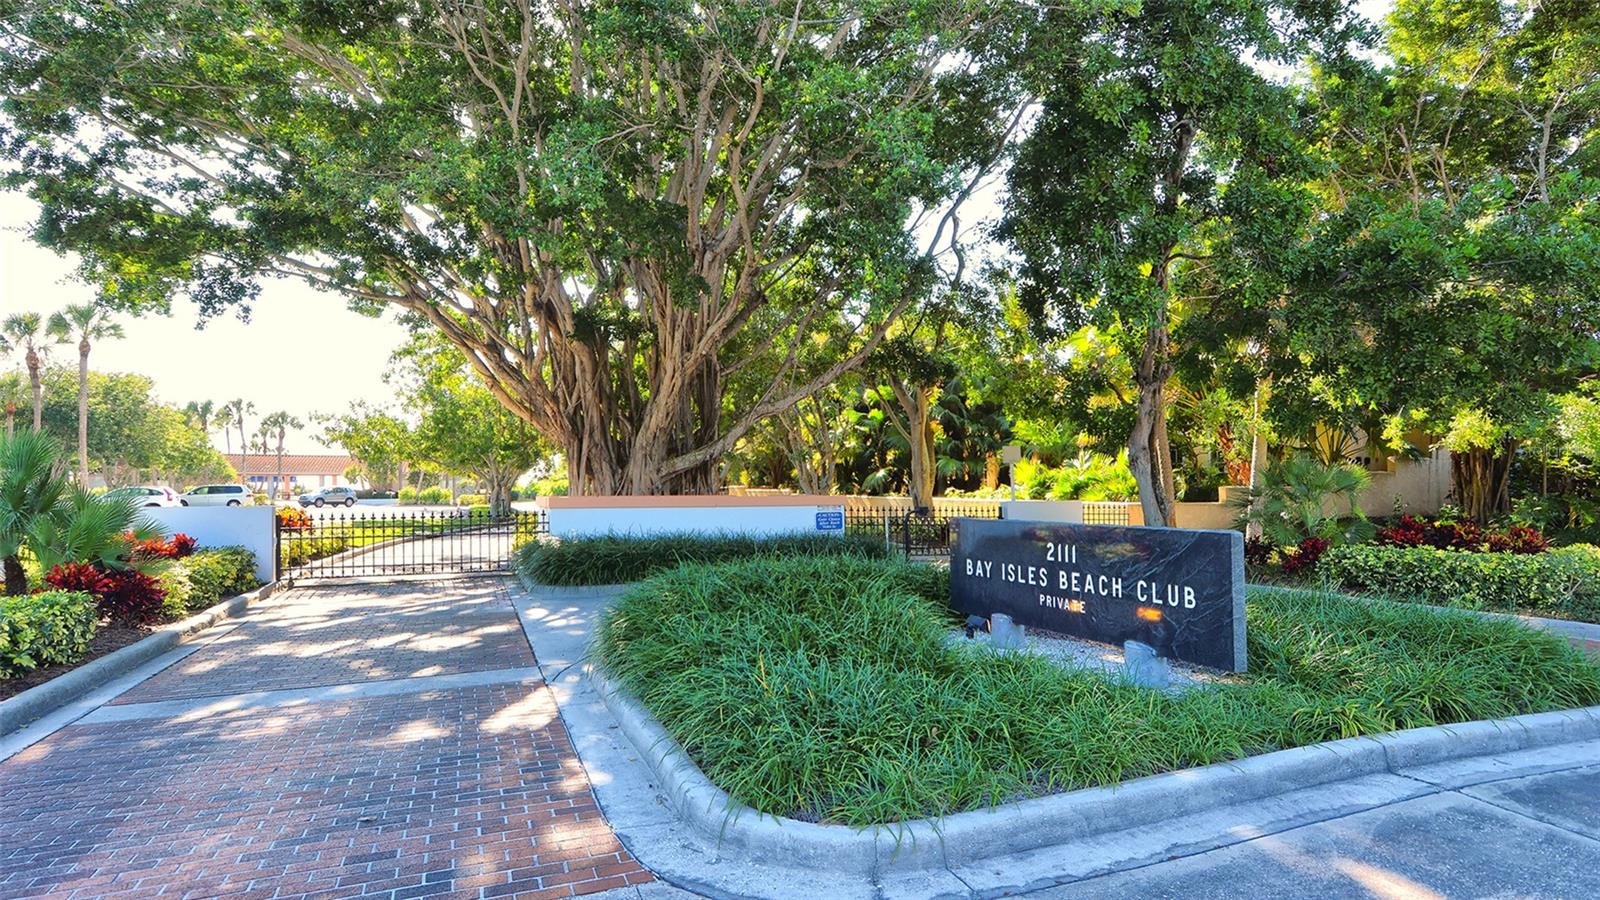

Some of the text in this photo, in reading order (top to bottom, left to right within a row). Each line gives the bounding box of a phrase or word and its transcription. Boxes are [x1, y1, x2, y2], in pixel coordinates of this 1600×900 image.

[1046, 542, 1077, 564] 2111
[966, 558, 1196, 609] BAY ISLES BEACH CLUB
